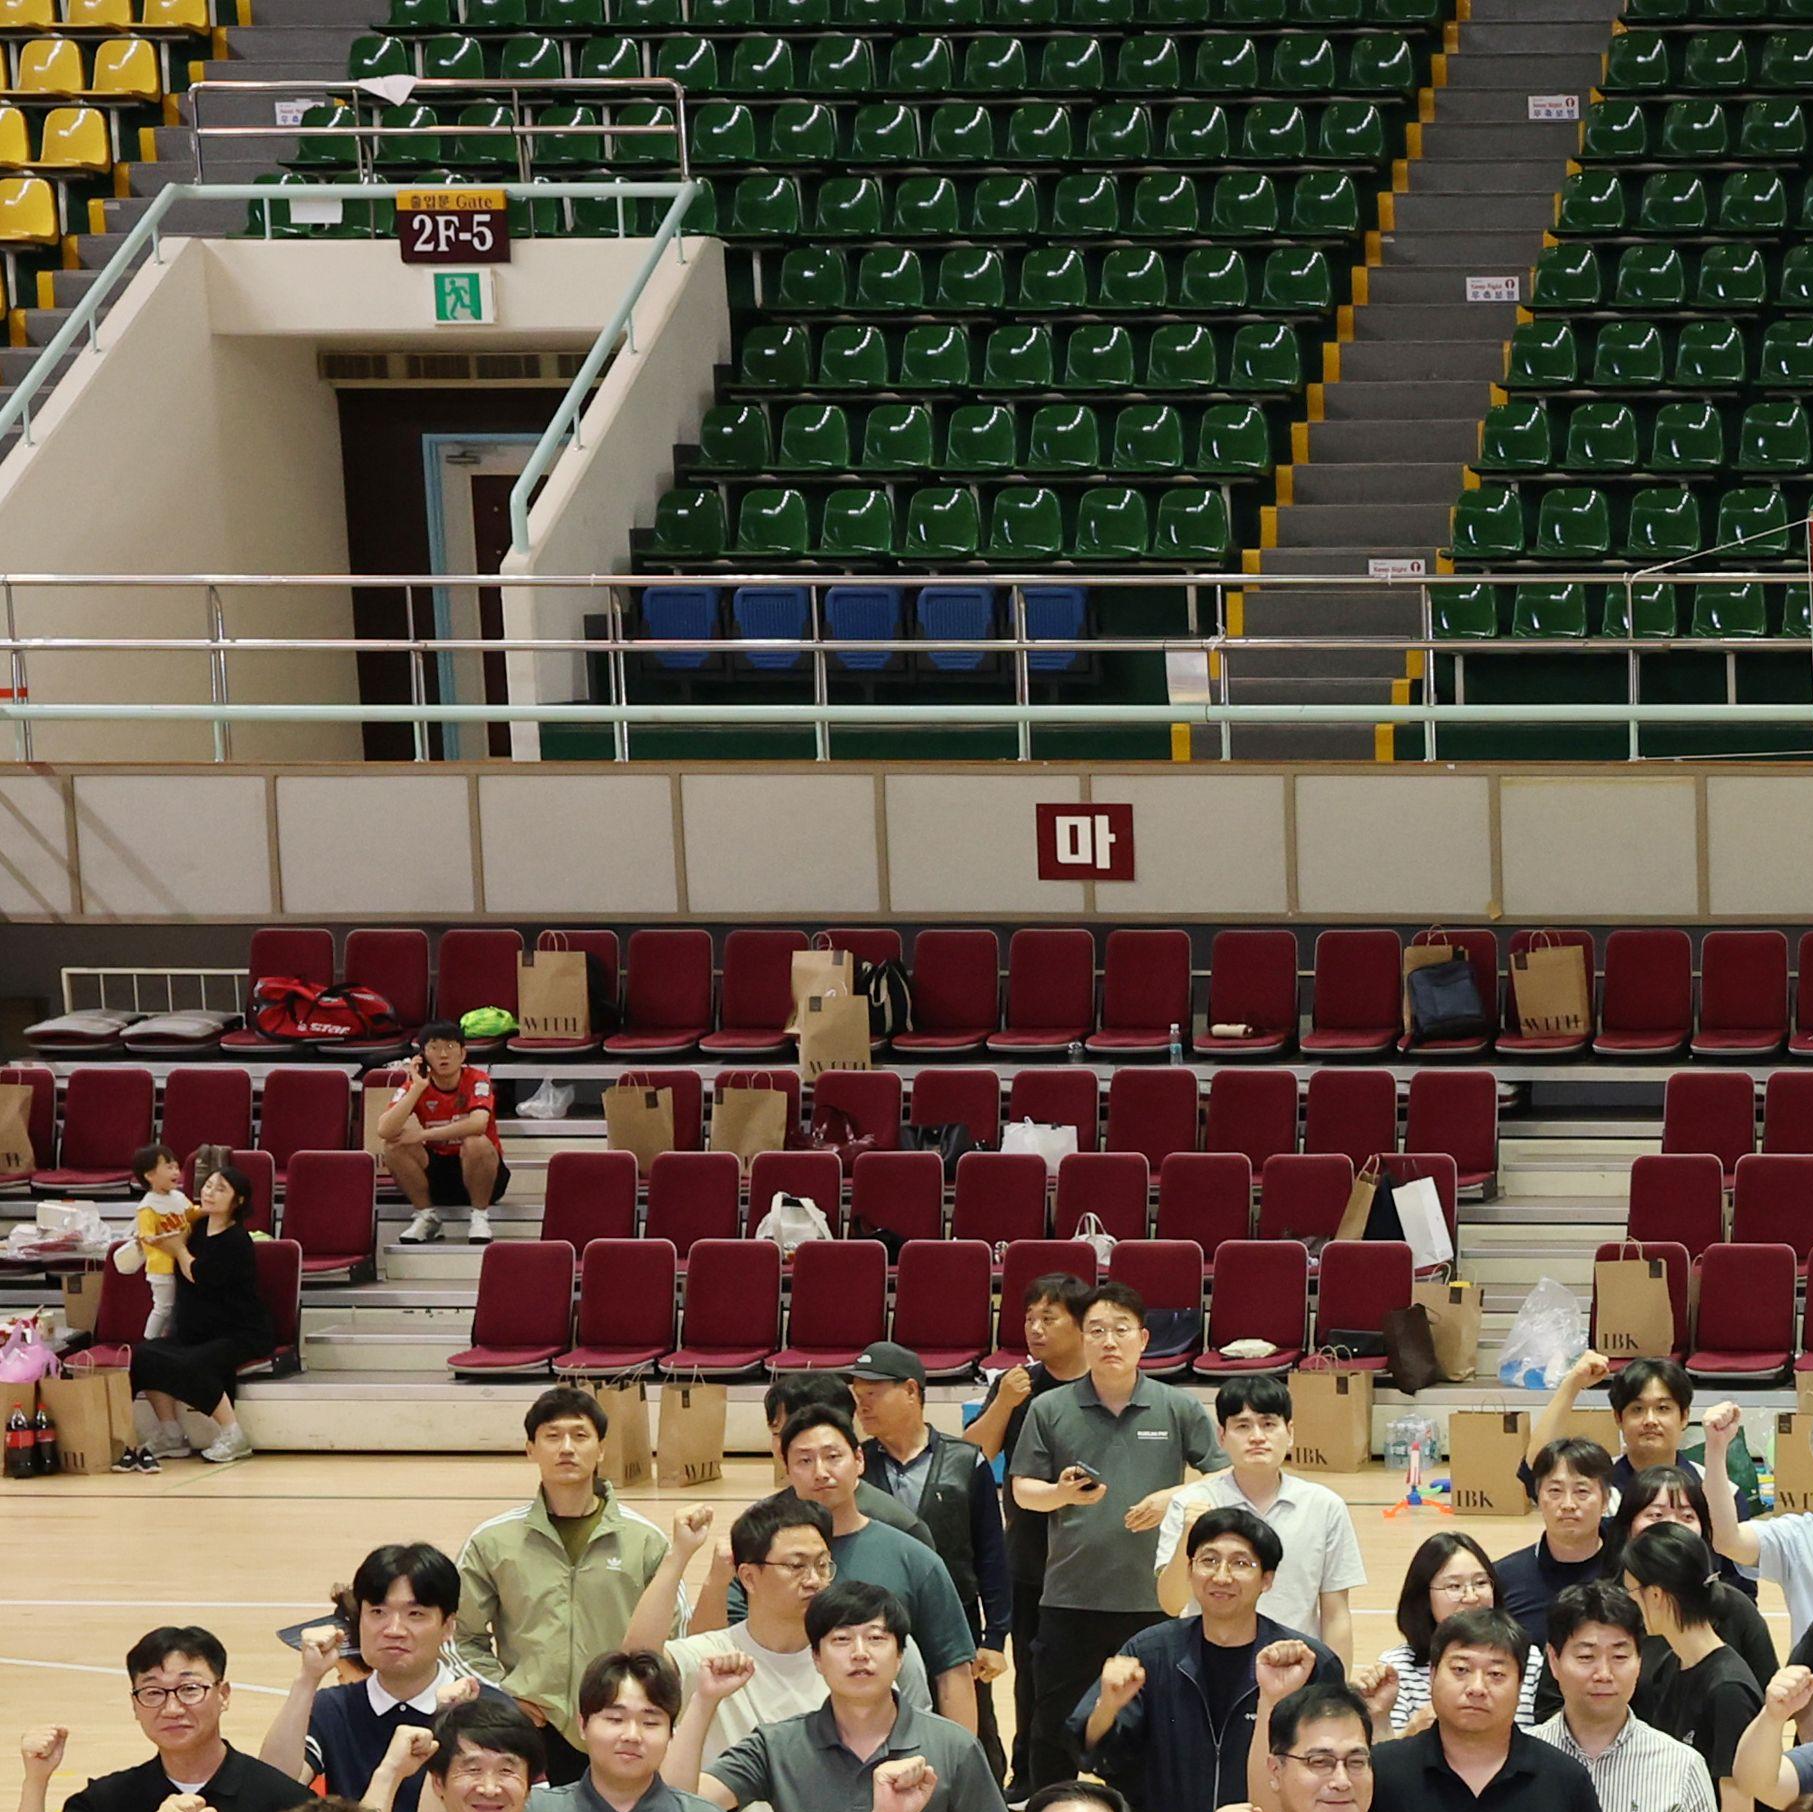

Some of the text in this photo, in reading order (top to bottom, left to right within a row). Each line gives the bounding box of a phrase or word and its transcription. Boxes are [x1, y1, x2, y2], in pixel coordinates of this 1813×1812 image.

[457, 195, 493, 209] Gate
[412, 214, 494, 252] 2F-5
[1055, 815, 1117, 870] 마
[523, 1016, 578, 1033] WITH
[1521, 1013, 1582, 1031] WITH
[1604, 1333, 1639, 1350] IBK
[1296, 1447, 1328, 1466] IBK
[1457, 1490, 1493, 1508] IBK
